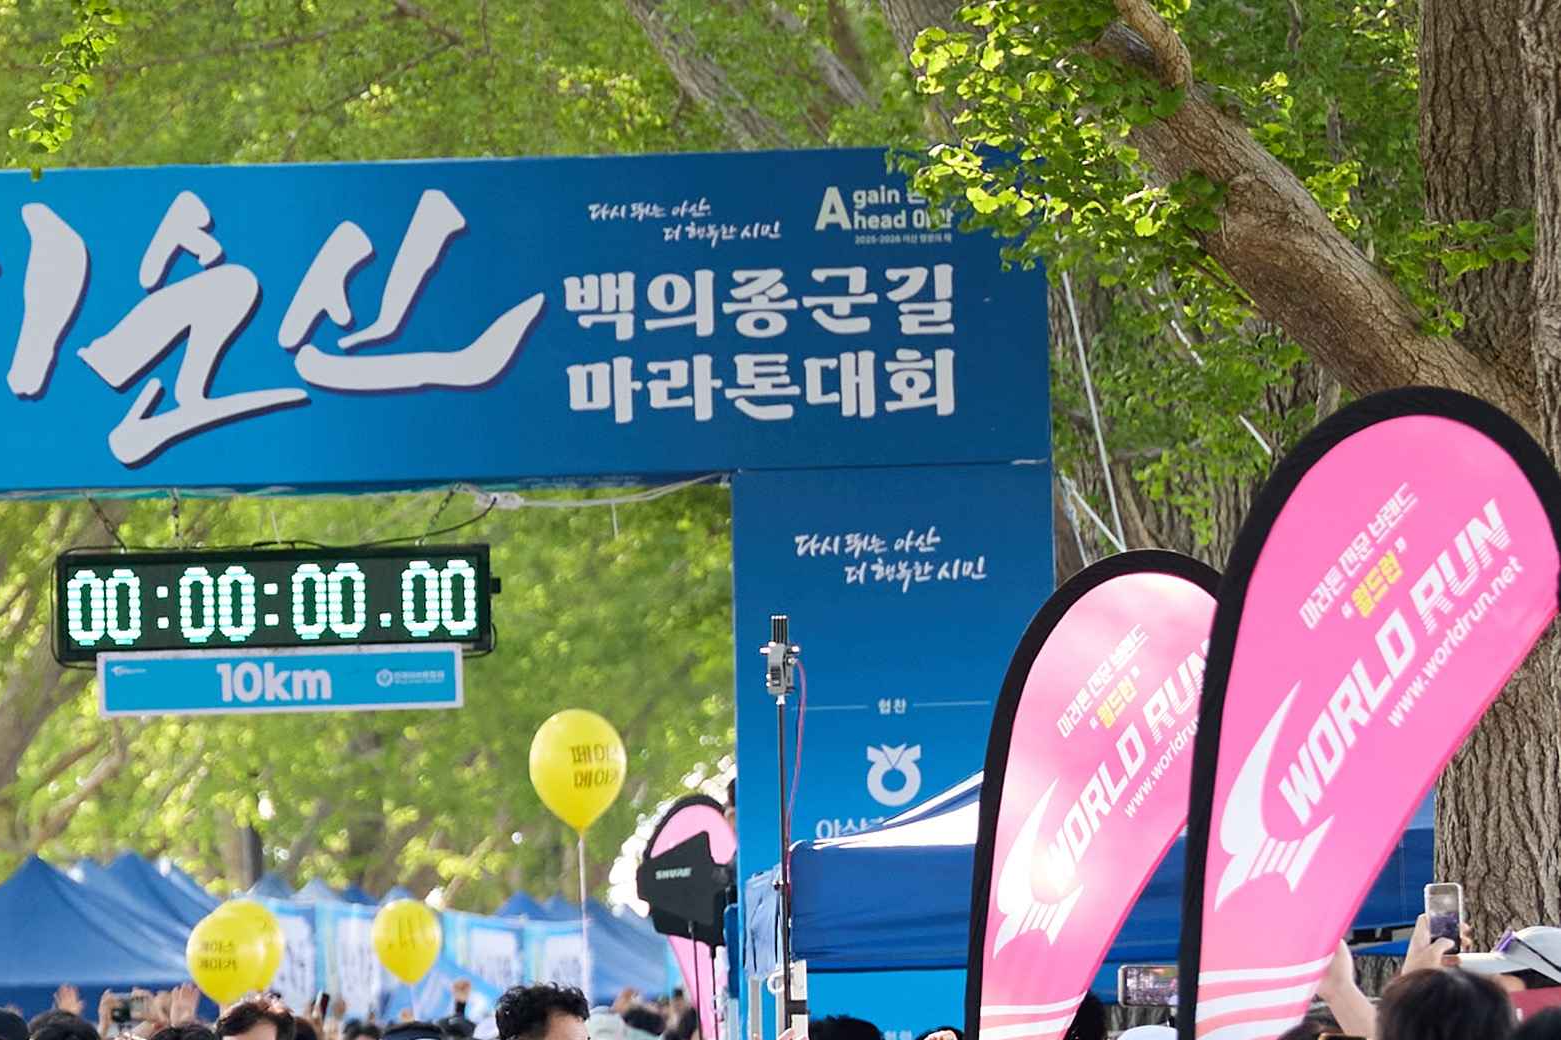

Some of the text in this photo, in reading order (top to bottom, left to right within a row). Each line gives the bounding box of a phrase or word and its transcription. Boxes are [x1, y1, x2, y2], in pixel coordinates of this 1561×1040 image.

[740, 219, 782, 241] 시민
[563, 263, 955, 341] 백의종군길
[566, 348, 957, 424] 마라톤대회
[795, 532, 840, 558] 다시
[894, 526, 940, 554] 아산
[845, 557, 988, 594] 더 행복한 시민
[1298, 565, 1348, 630] 마라톤
[1278, 498, 1513, 827] WORLD RUN
[1387, 555, 1525, 729] www.worldrun.net
[216, 662, 332, 702] 10km
